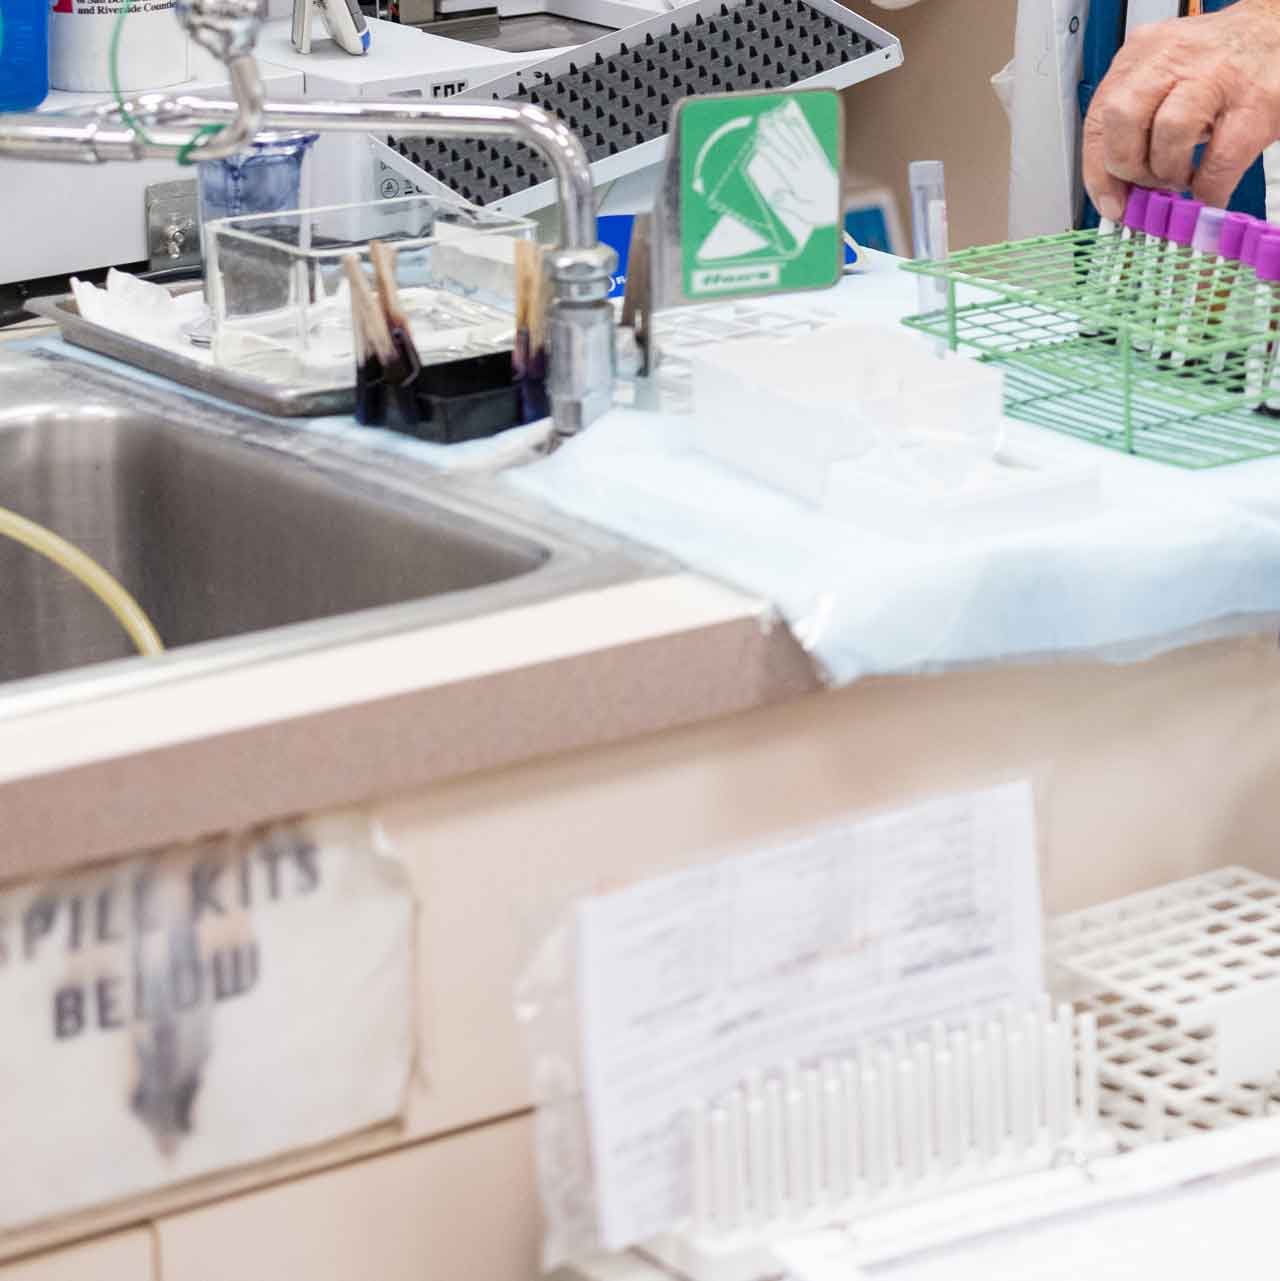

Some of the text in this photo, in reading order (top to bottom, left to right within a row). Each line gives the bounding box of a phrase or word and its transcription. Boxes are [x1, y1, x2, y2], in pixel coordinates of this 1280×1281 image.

[78, 6, 95, 15] and
[190, 839, 321, 922] KITS
[53, 938, 261, 1043] BELOW
